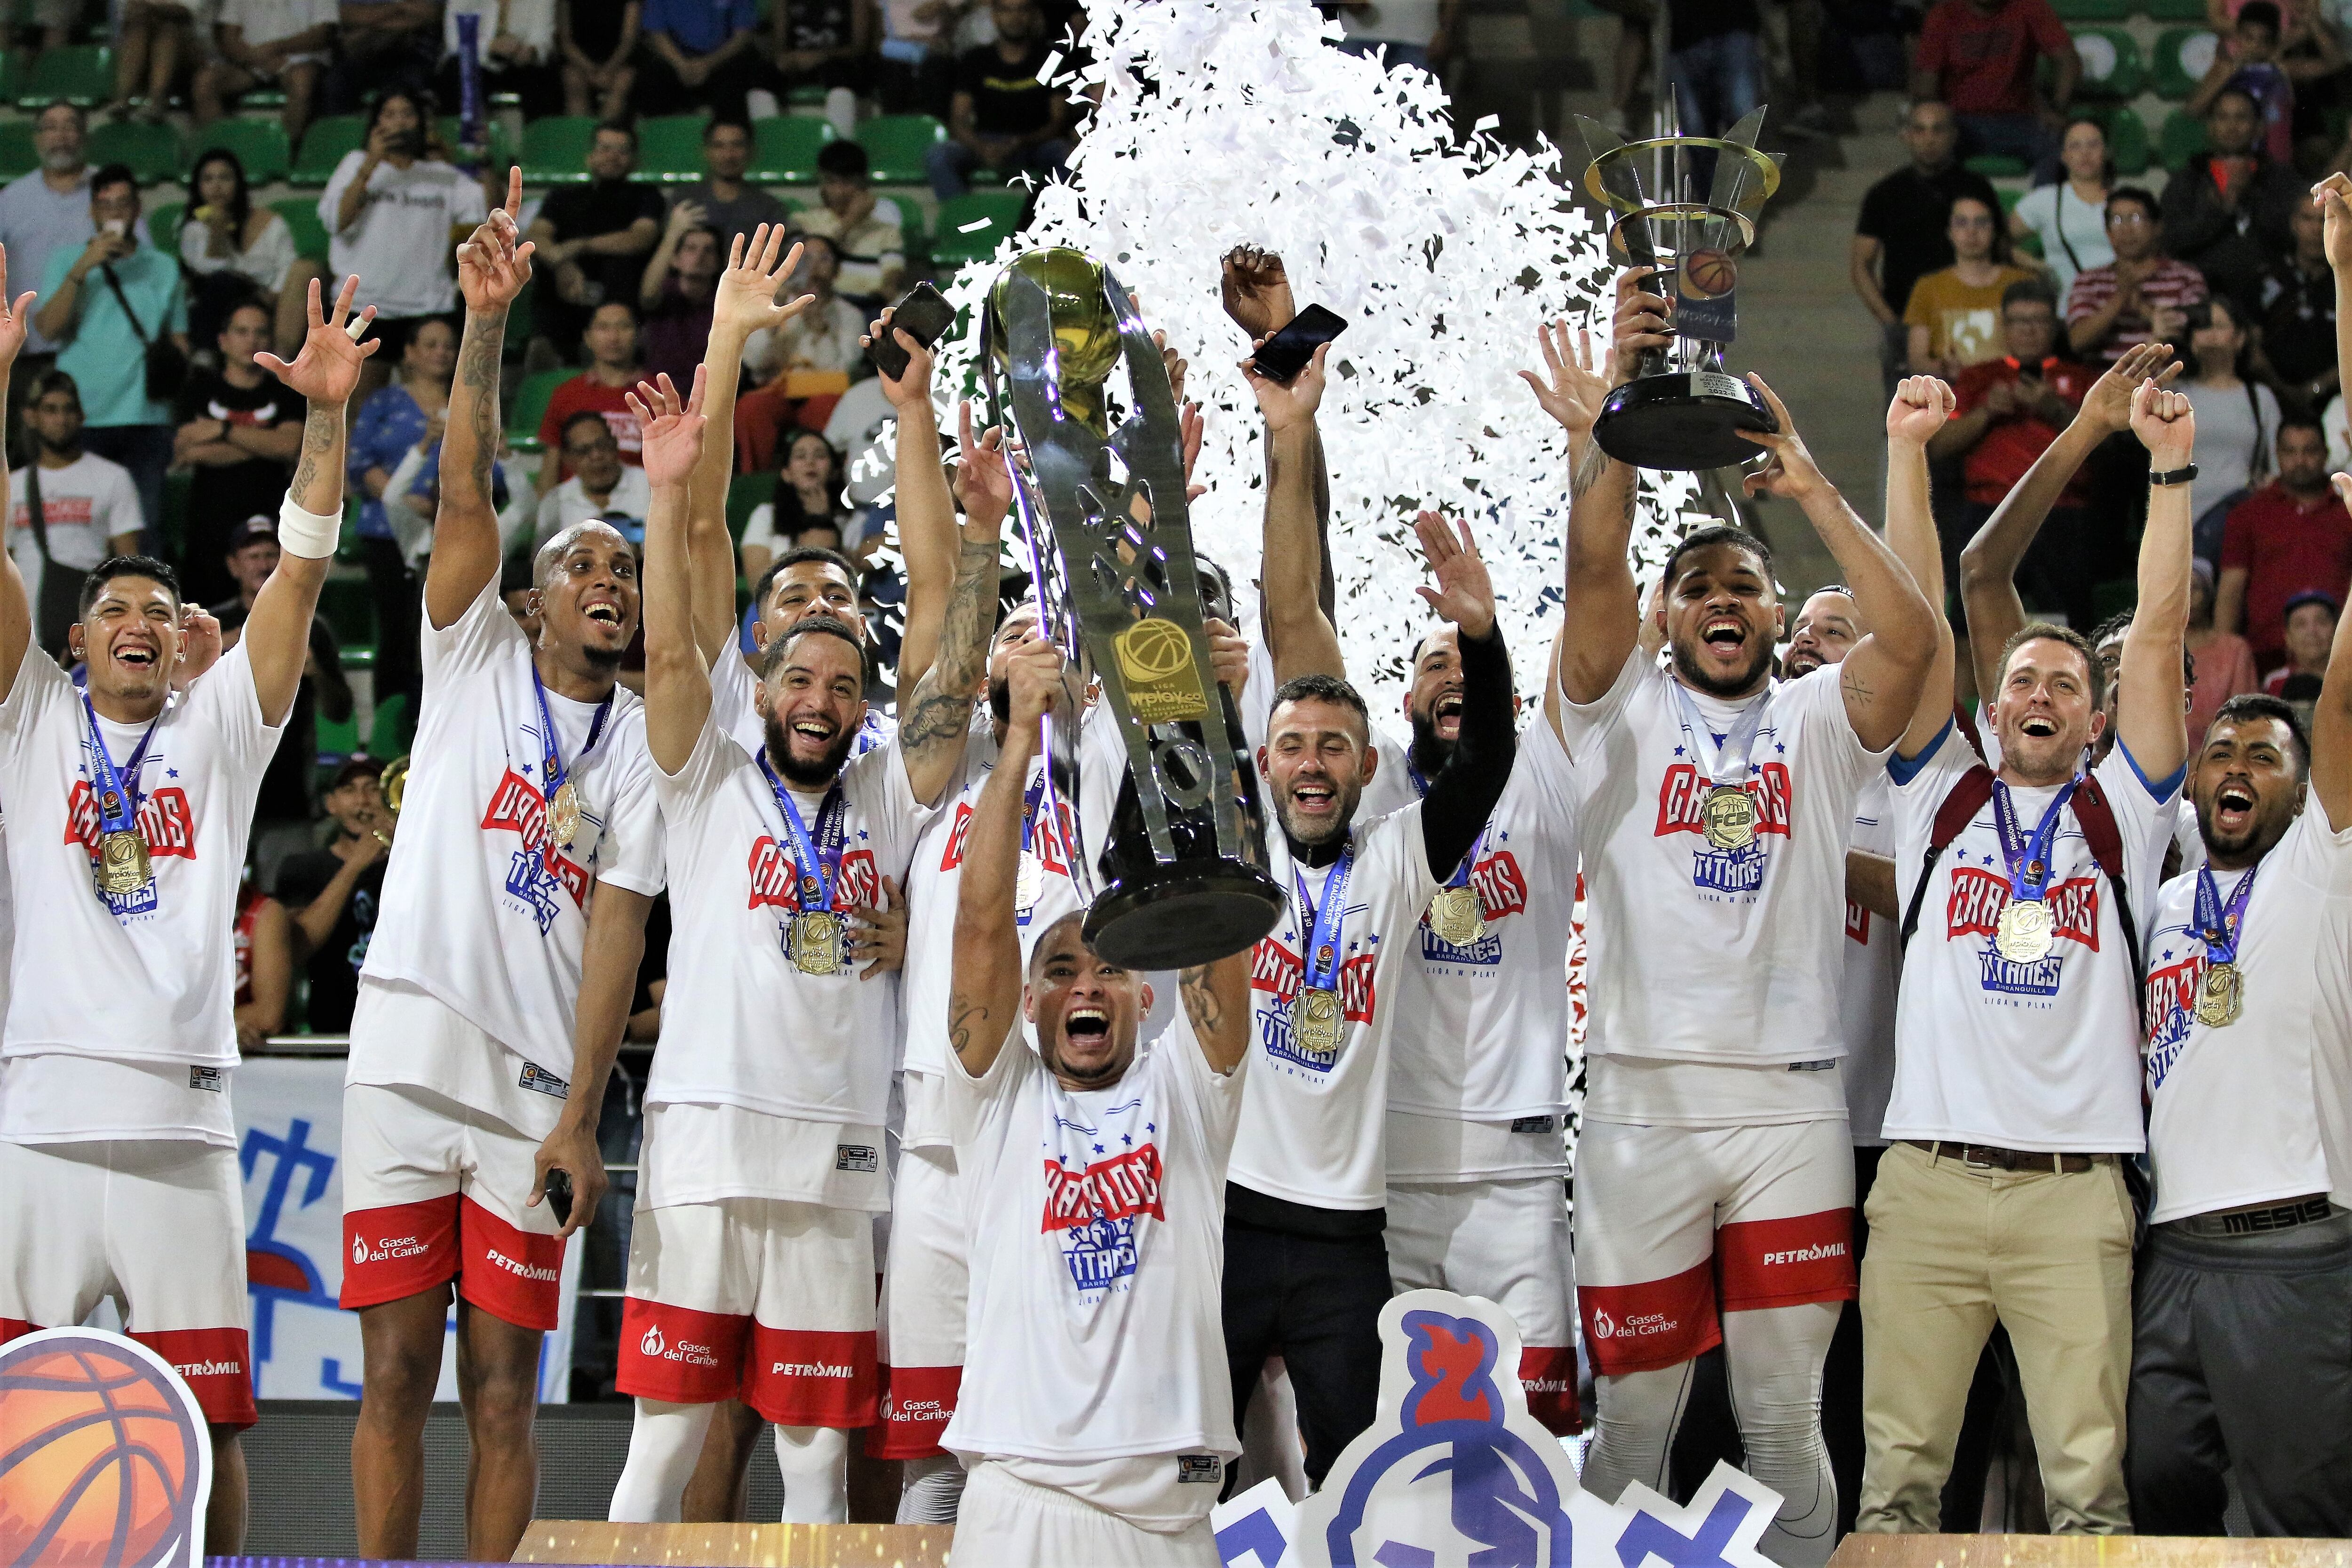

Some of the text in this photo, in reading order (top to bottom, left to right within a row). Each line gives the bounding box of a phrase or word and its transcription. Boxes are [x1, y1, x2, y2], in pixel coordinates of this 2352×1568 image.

[1712, 811, 1751, 828] FCB
[2000, 786, 2018, 851] DIVISIÓN PROFESIONAL
[819, 830, 830, 855] DIVISIÓN
[830, 838, 838, 846] DE
[792, 833, 812, 872] COLOMBIANA
[1324, 874, 1346, 925] DE BALONCESTO
[1698, 894, 1720, 902] LIGA
[1305, 917, 1318, 927] DE
[1328, 899, 1349, 942] COLOMBIANA
[1979, 954, 2061, 987] TITANES
[1985, 997, 2008, 1006] LIGA
[2027, 1002, 2052, 1010] PLAY
[1268, 1047, 1320, 1070] BARRANQUILLA
[1301, 1073, 1325, 1084] PLAY
[379, 1236, 417, 1249] Gases
[369, 1243, 429, 1262] del Caribe
[1763, 1242, 1846, 1266] PETROMIL
[485, 1249, 557, 1281] PETROMIL
[1616, 1319, 1678, 1337] del Caribe
[1625, 1313, 1664, 1325] Gases
[677, 1340, 710, 1354] Gases
[663, 1348, 718, 1366] del Caribe
[174, 1359, 241, 1377] ETROMIL
[771, 1360, 854, 1378] PETROMIL
[903, 1400, 940, 1411] Gases
[892, 1409, 954, 1422] del Caribe
